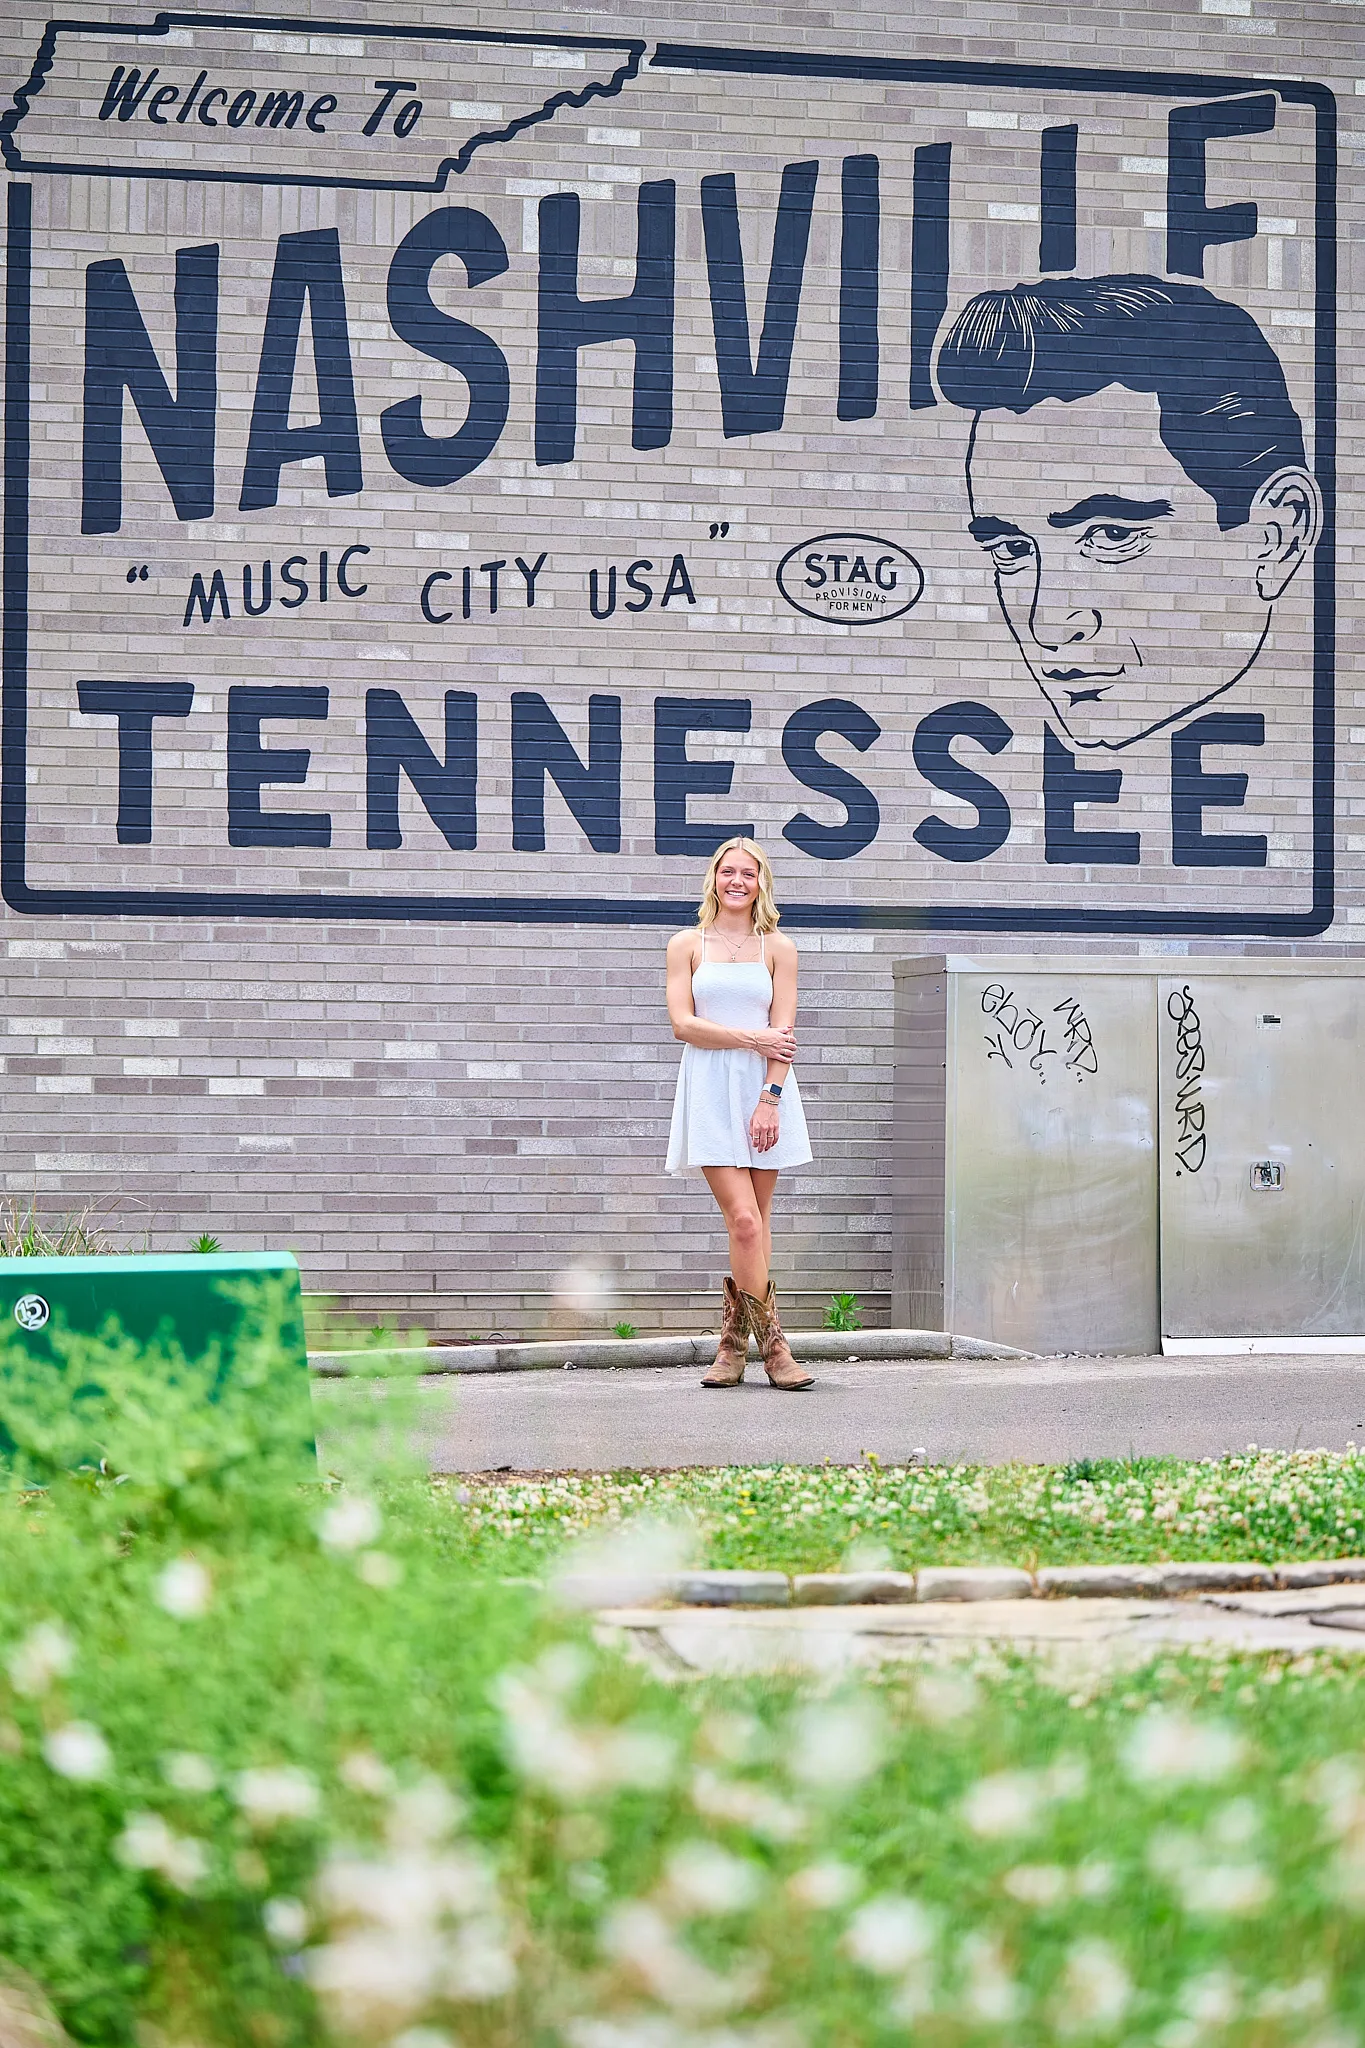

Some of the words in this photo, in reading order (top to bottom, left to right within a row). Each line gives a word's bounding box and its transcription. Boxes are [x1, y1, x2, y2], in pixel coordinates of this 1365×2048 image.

[98, 66, 337, 134] Welcome
[362, 80, 423, 138] To
[183, 544, 370, 627] MUSIC
[421, 552, 548, 624] CITY
[589, 554, 697, 620] USA
[804, 553, 898, 591] STAG
[815, 587, 888, 605] PROVISIONS
[829, 601, 850, 612] FOR
[852, 602, 873, 612] MEN
[76, 680, 1268, 867] TENNESSEE
